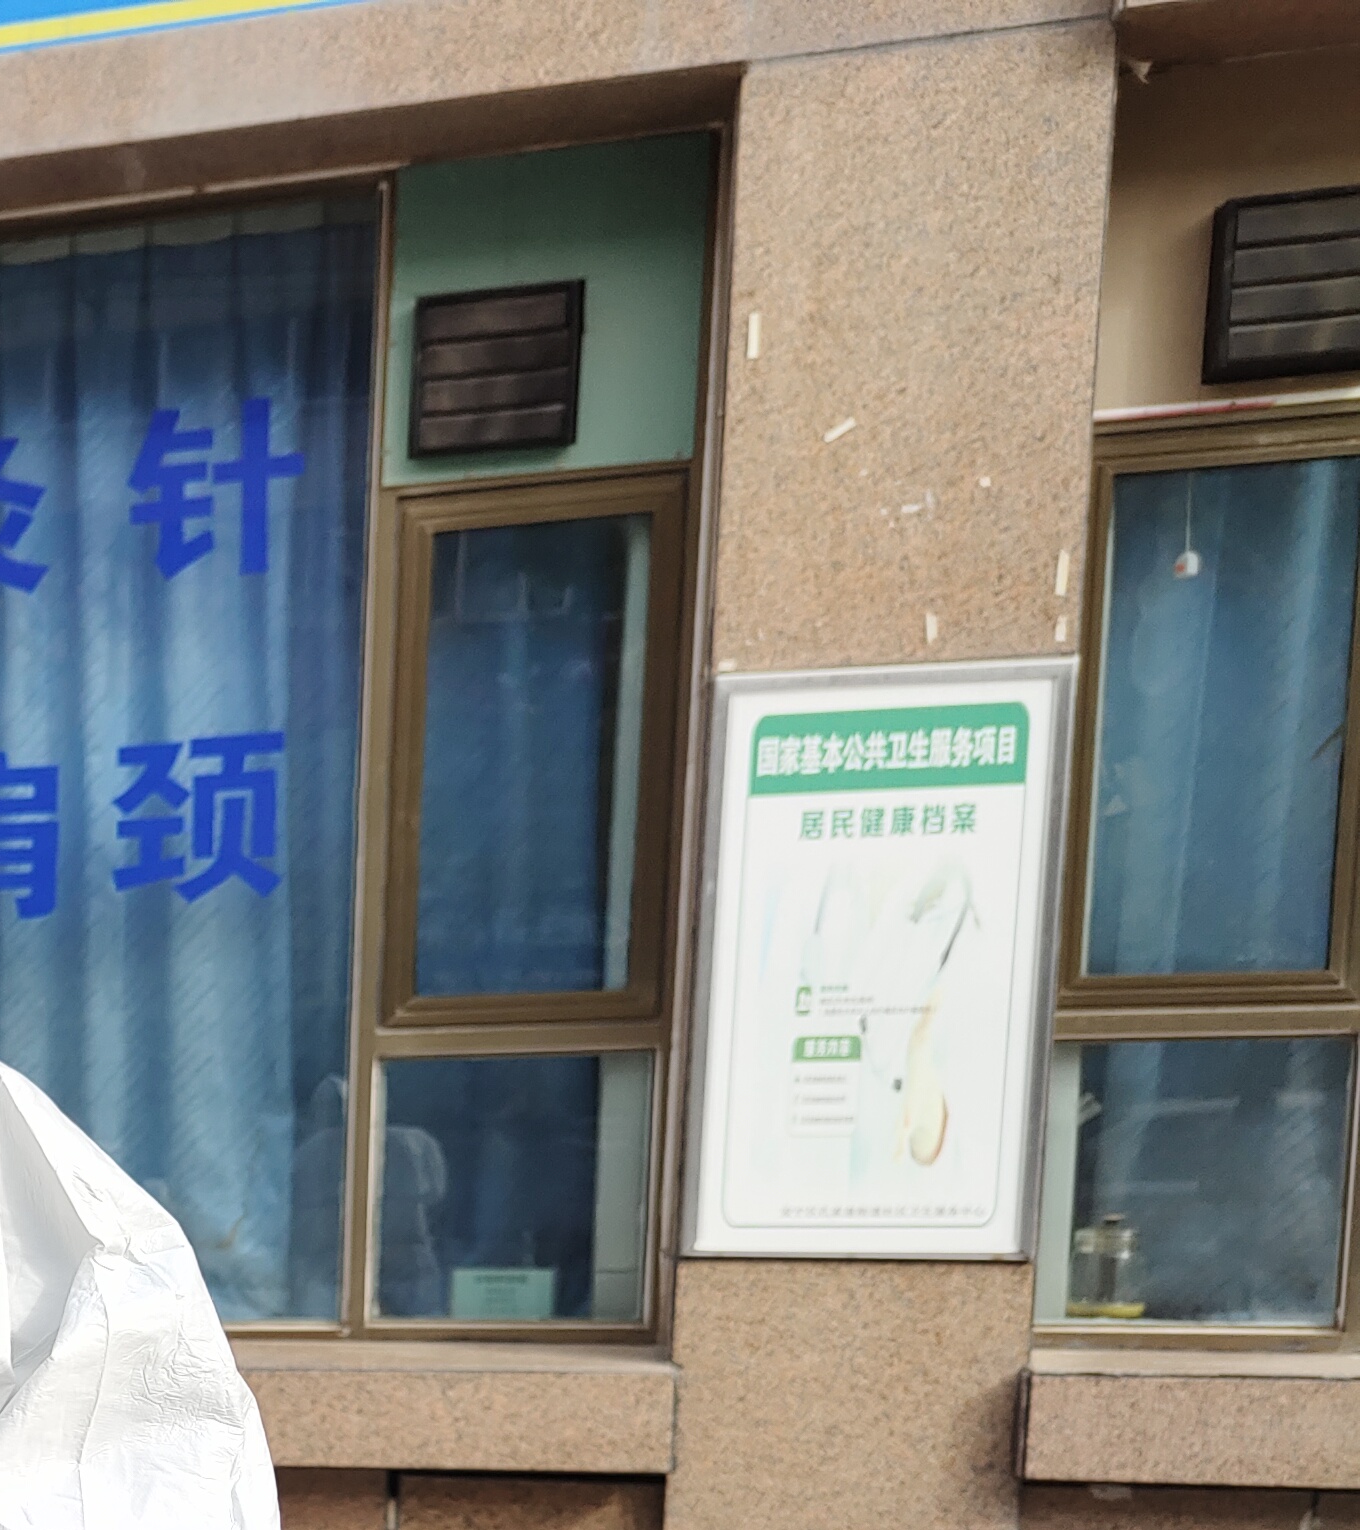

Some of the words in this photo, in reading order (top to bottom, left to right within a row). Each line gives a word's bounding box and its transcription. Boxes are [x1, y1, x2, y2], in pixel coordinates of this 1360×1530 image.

[756, 725, 1018, 778] 国家基本公共卫生服务项目
[798, 802, 978, 841] 居民健康档案
